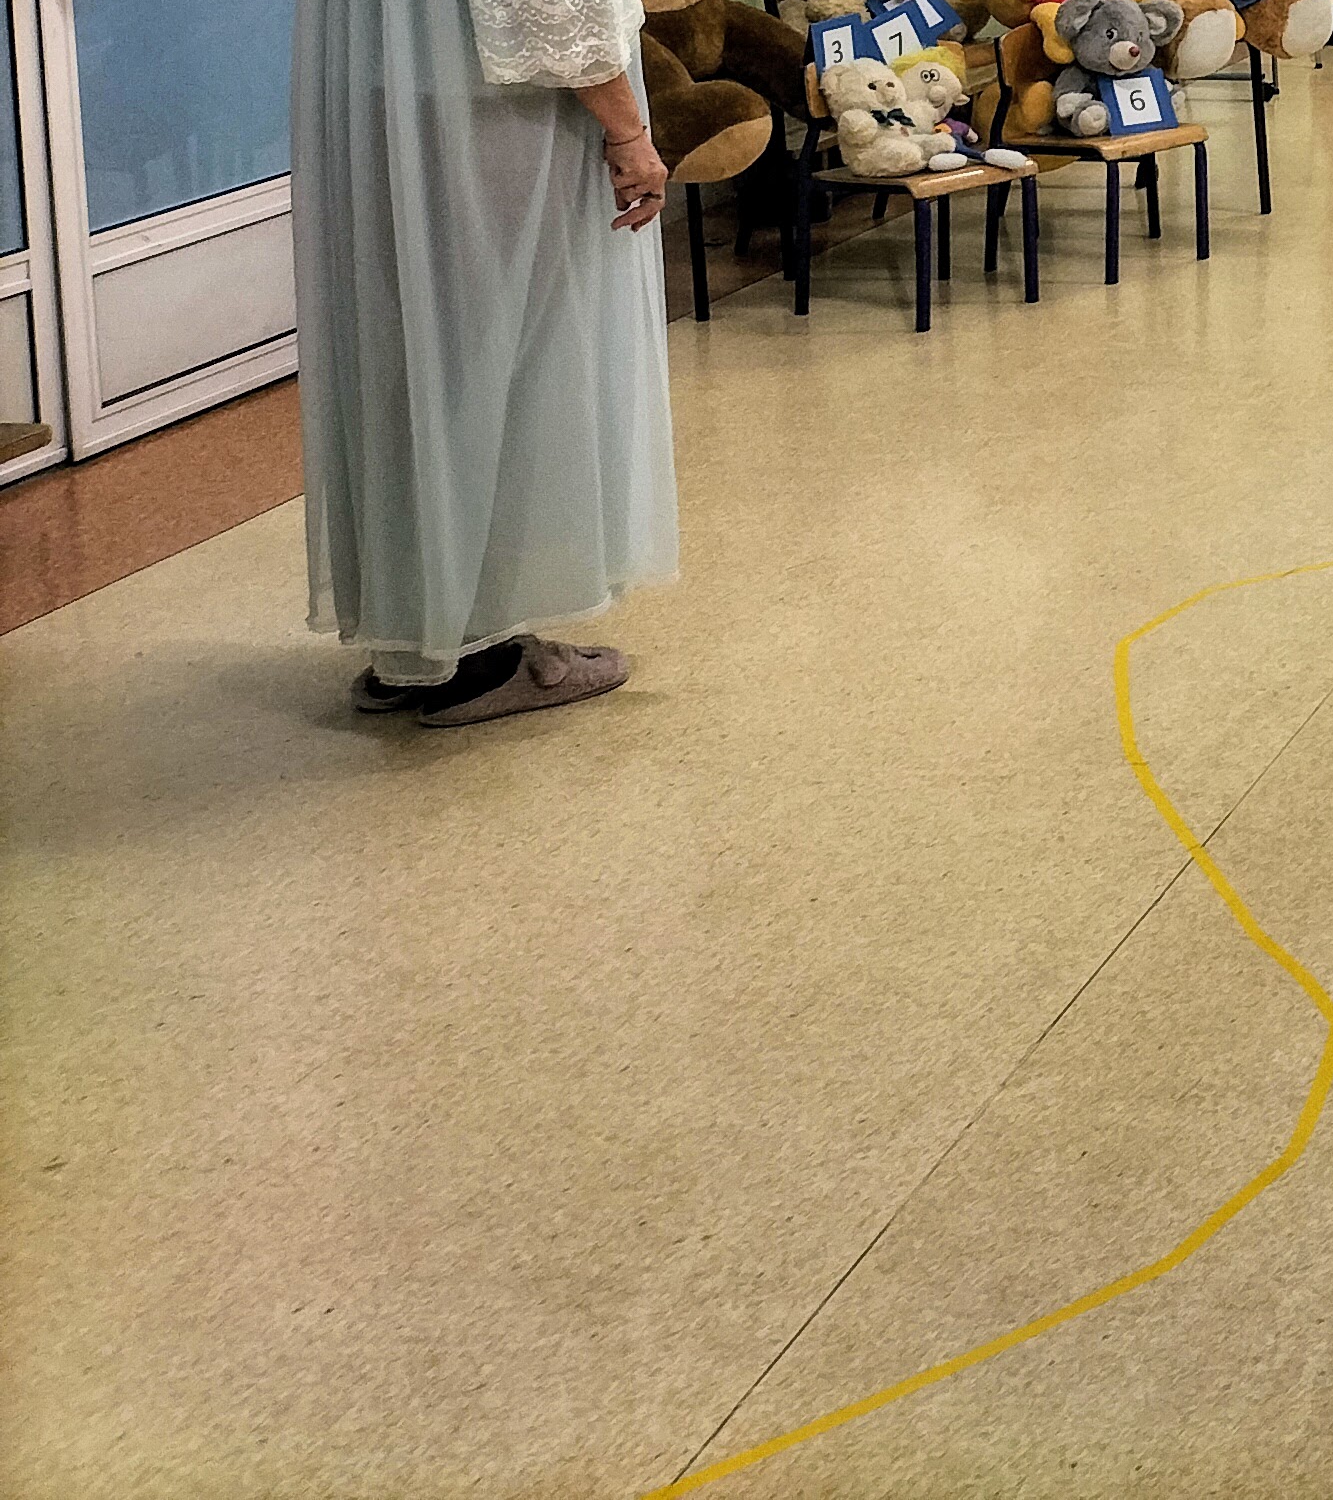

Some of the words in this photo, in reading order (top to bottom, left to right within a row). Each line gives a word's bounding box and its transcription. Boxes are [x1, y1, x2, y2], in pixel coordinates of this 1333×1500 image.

[831, 40, 844, 64] 3
[888, 31, 903, 57] 7
[1129, 89, 1146, 112] 6
